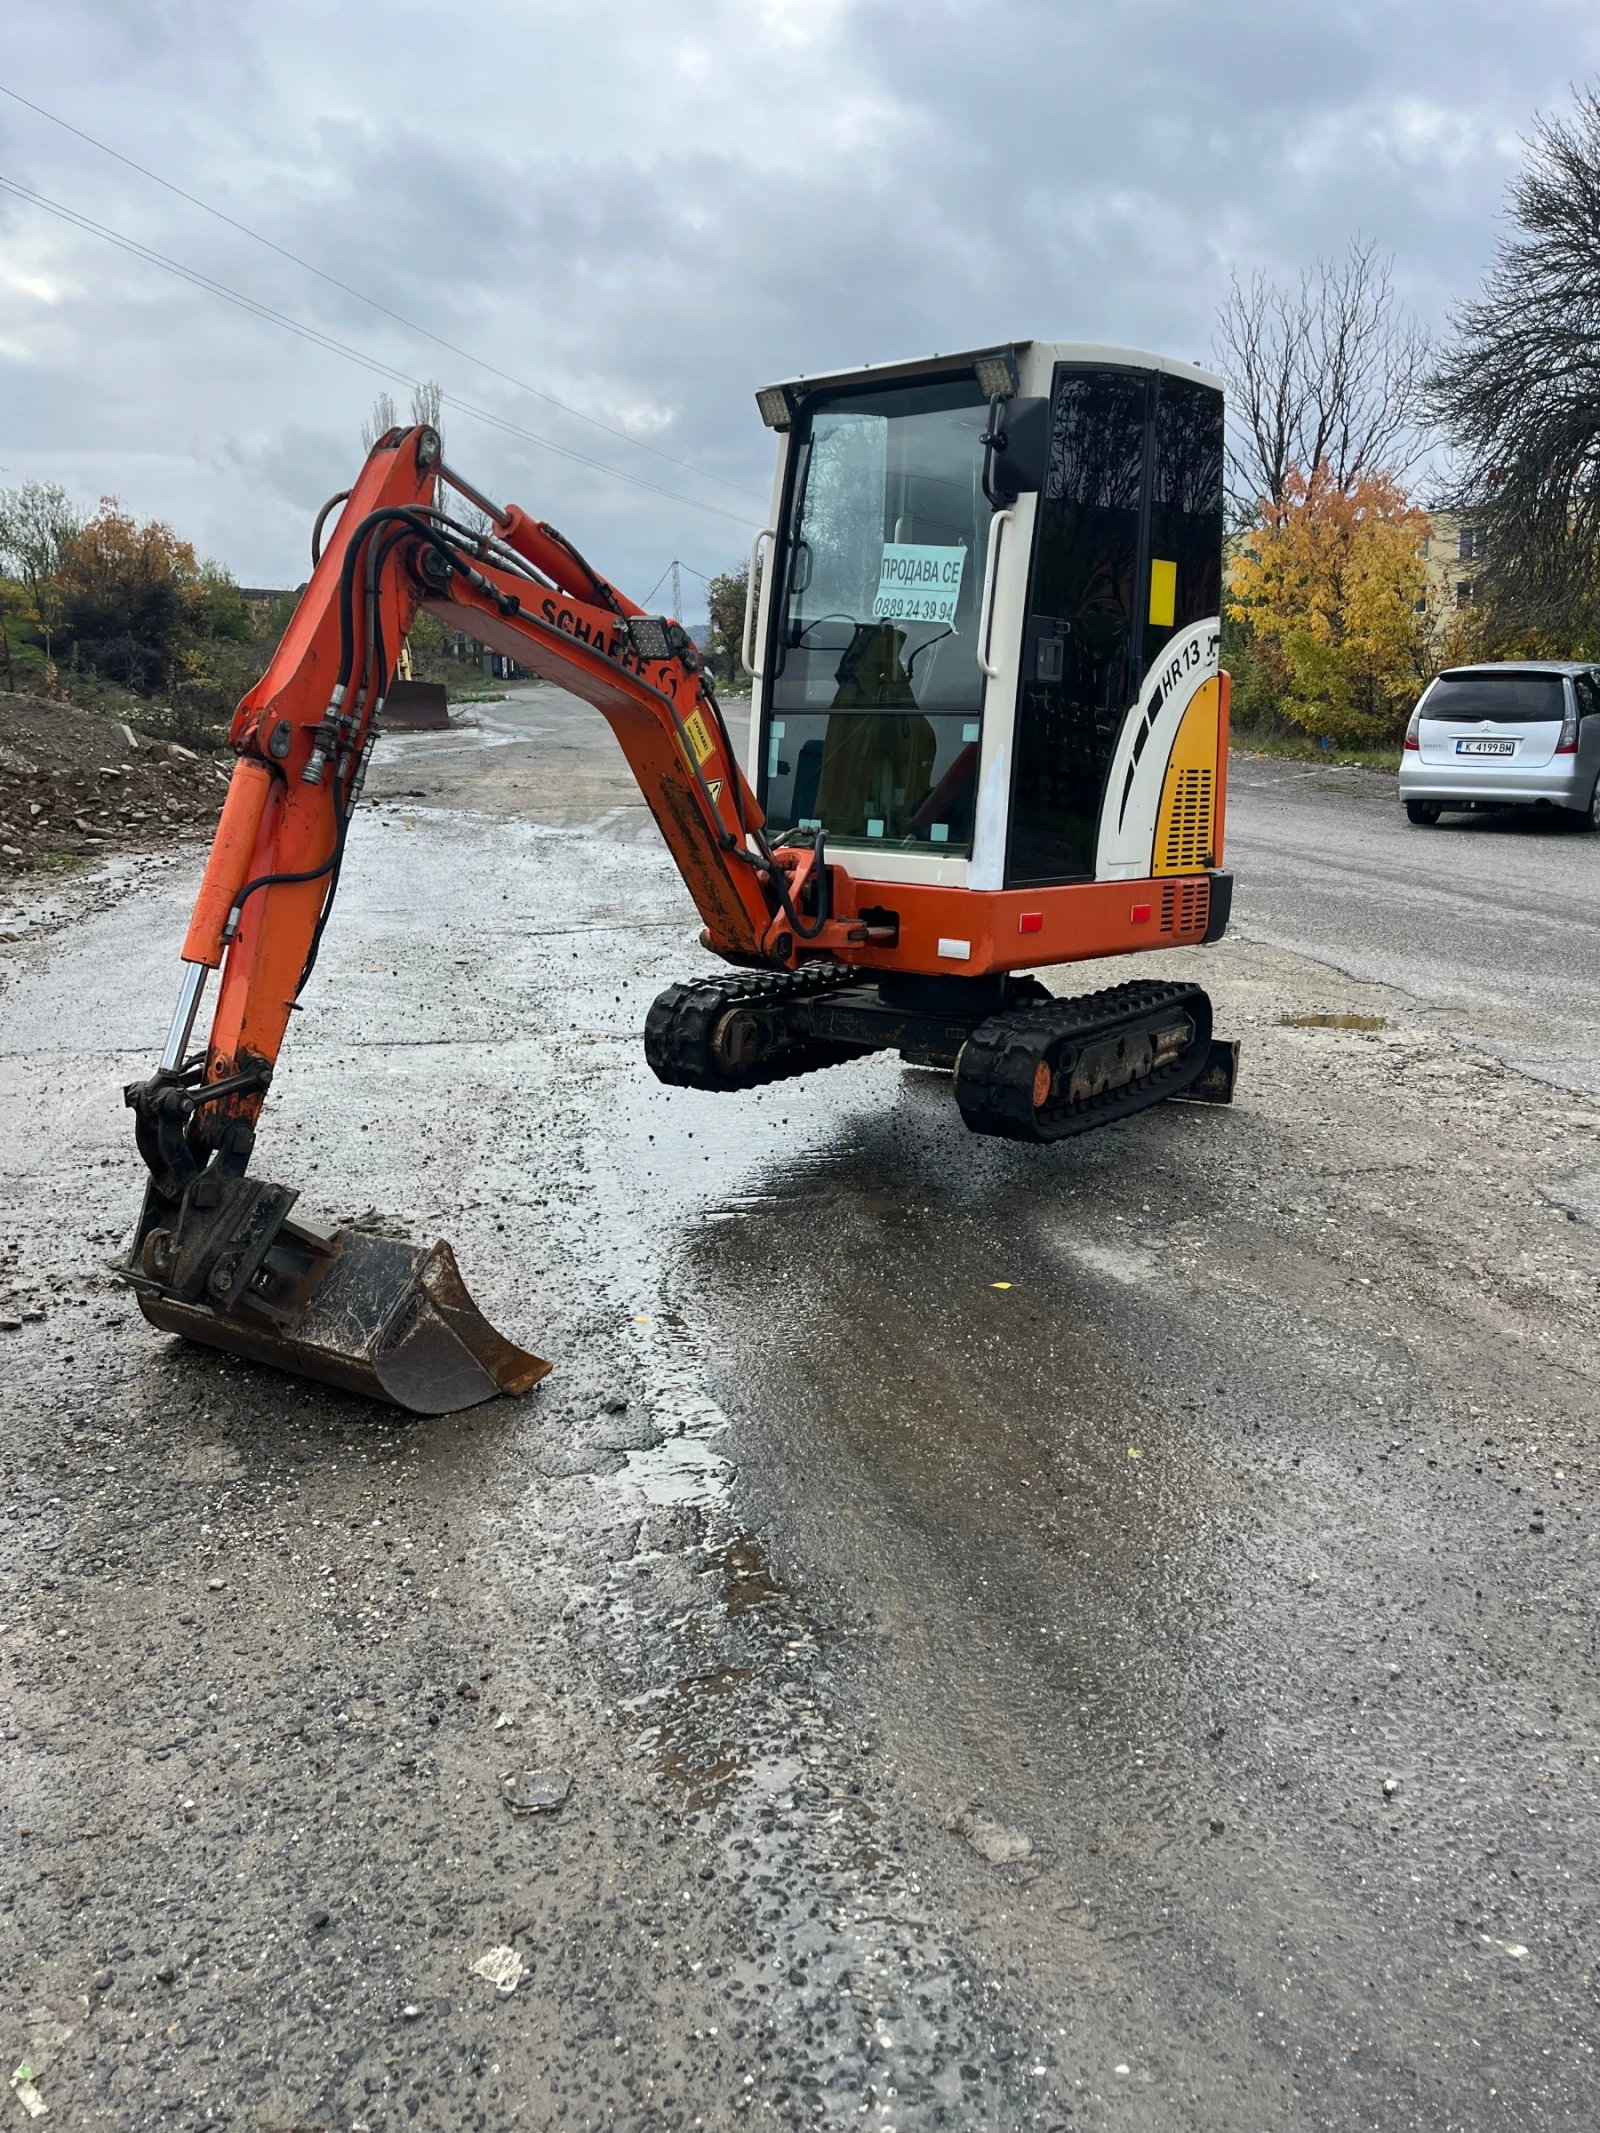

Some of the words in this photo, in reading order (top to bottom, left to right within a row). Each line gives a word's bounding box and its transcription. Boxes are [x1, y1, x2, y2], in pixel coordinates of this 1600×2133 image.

[881, 558, 939, 586] ПРОДАВА
[942, 561, 961, 584] СЕ
[874, 597, 904, 617] 0889
[905, 599, 920, 618] 24
[922, 600, 937, 619] 39
[938, 601, 954, 620] 94
[1162, 658, 1183, 699] HR
[1182, 639, 1200, 671] 13
[1465, 742, 1472, 751] K
